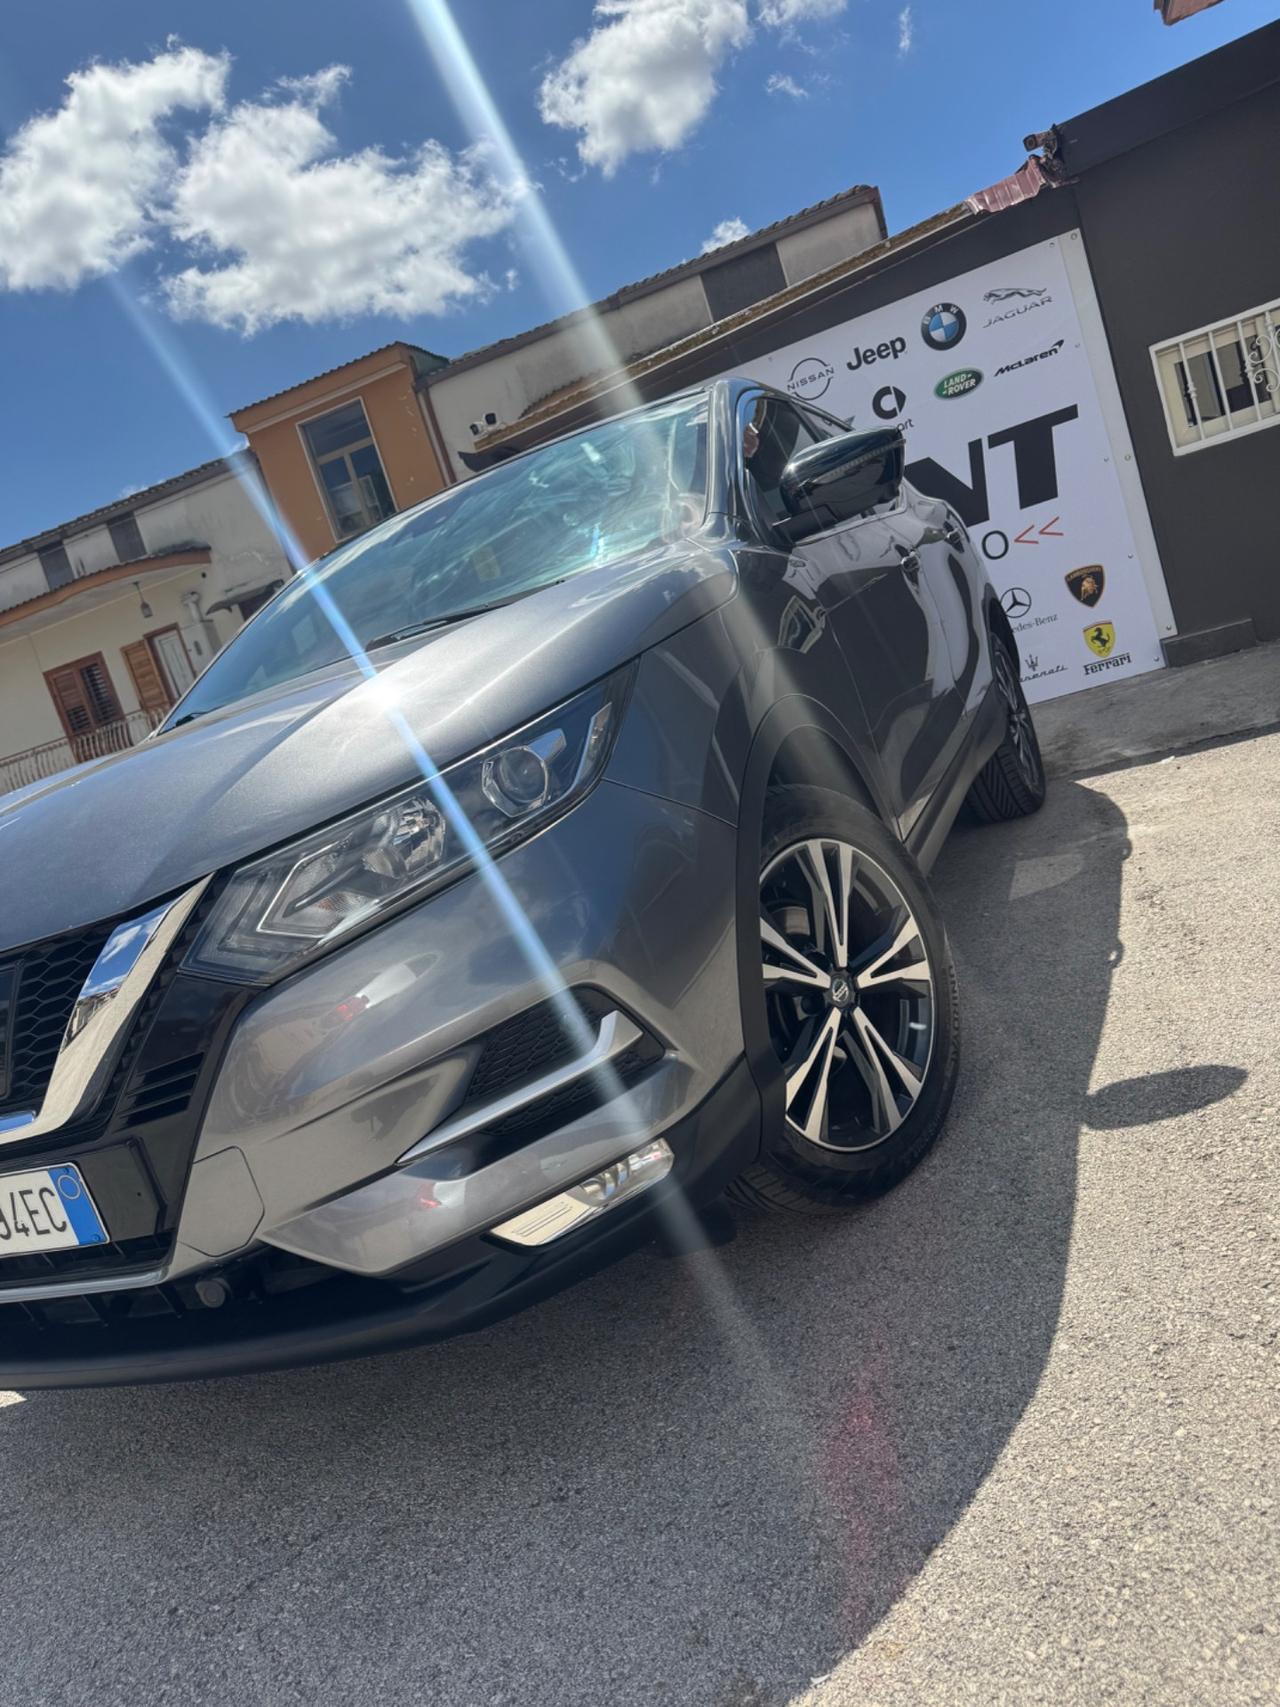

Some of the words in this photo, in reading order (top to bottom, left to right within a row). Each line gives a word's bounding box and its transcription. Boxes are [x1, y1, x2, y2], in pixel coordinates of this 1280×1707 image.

[922, 304, 960, 325] BMW
[982, 296, 1053, 328] JAGUAR
[846, 336, 907, 371] Jeep
[994, 344, 1060, 377] McLaren
[786, 366, 835, 392] NISSAN
[1012, 613, 1058, 633] edes-Benz
[1083, 652, 1132, 676] Ferrari
